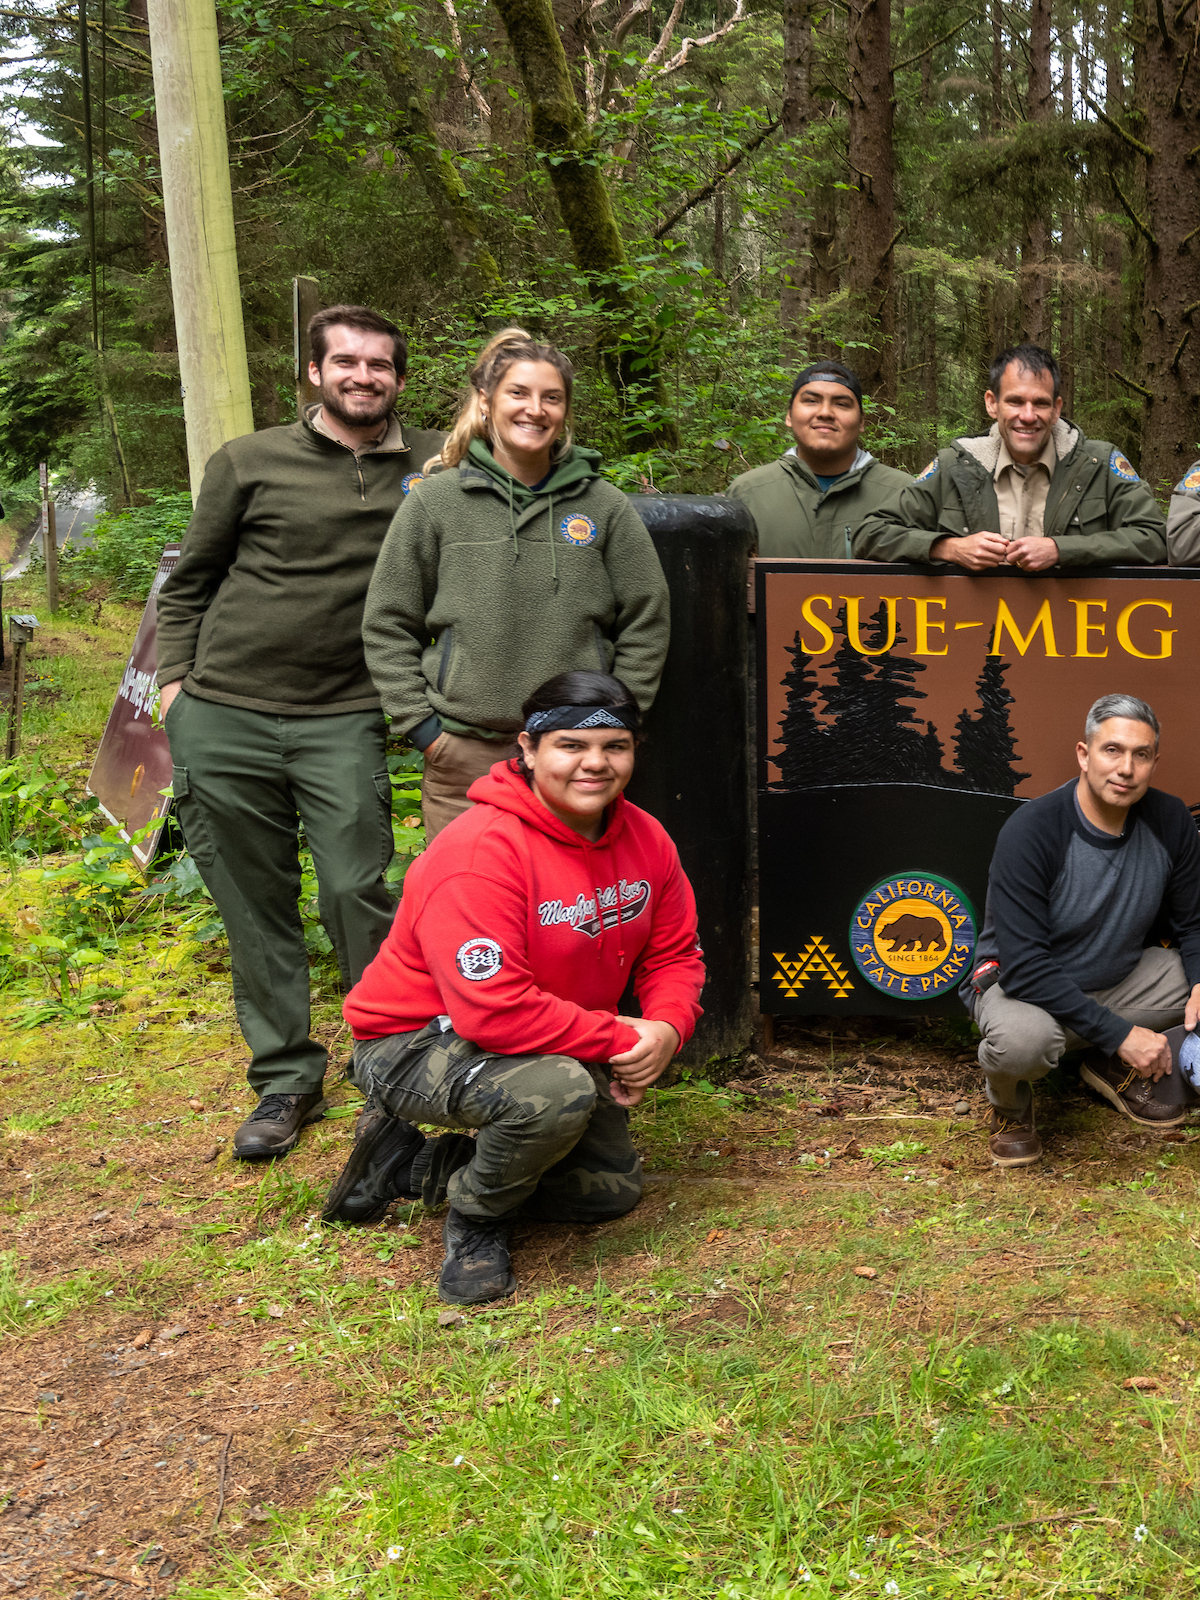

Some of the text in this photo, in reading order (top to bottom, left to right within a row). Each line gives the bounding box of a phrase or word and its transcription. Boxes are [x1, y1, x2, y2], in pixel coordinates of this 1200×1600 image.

[800, 593, 1178, 661] SUE-MEG
[857, 881, 967, 929] CALIFORNIA
[856, 943, 970, 993] STATE PARKS
[888, 954, 939, 962] SINCE 1864
